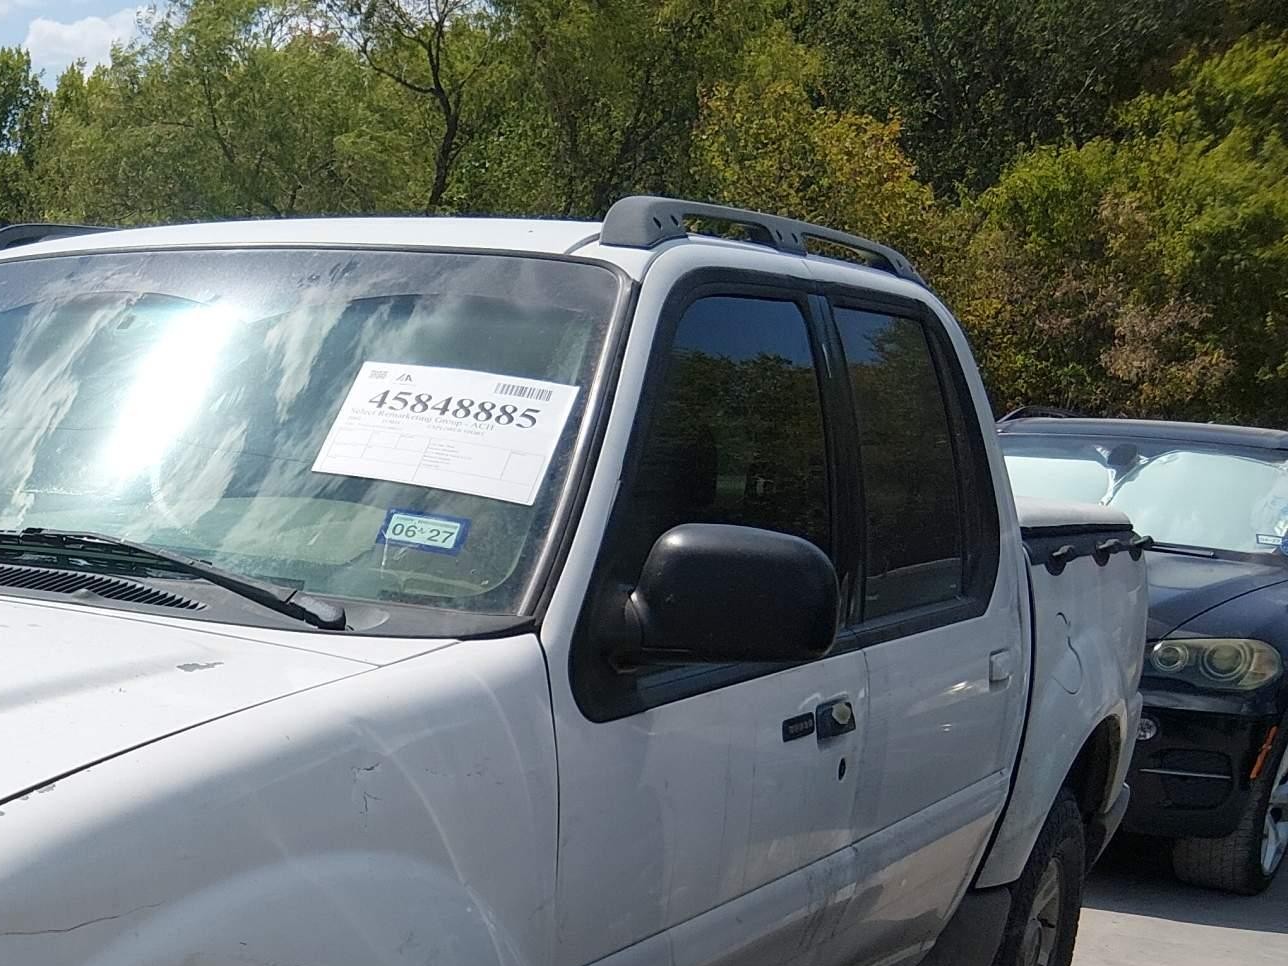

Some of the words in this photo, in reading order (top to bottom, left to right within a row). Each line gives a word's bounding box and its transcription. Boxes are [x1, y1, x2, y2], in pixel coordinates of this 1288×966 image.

[368, 389, 541, 429] 45848885
[392, 523, 418, 538] 06
[427, 529, 455, 543] 27
